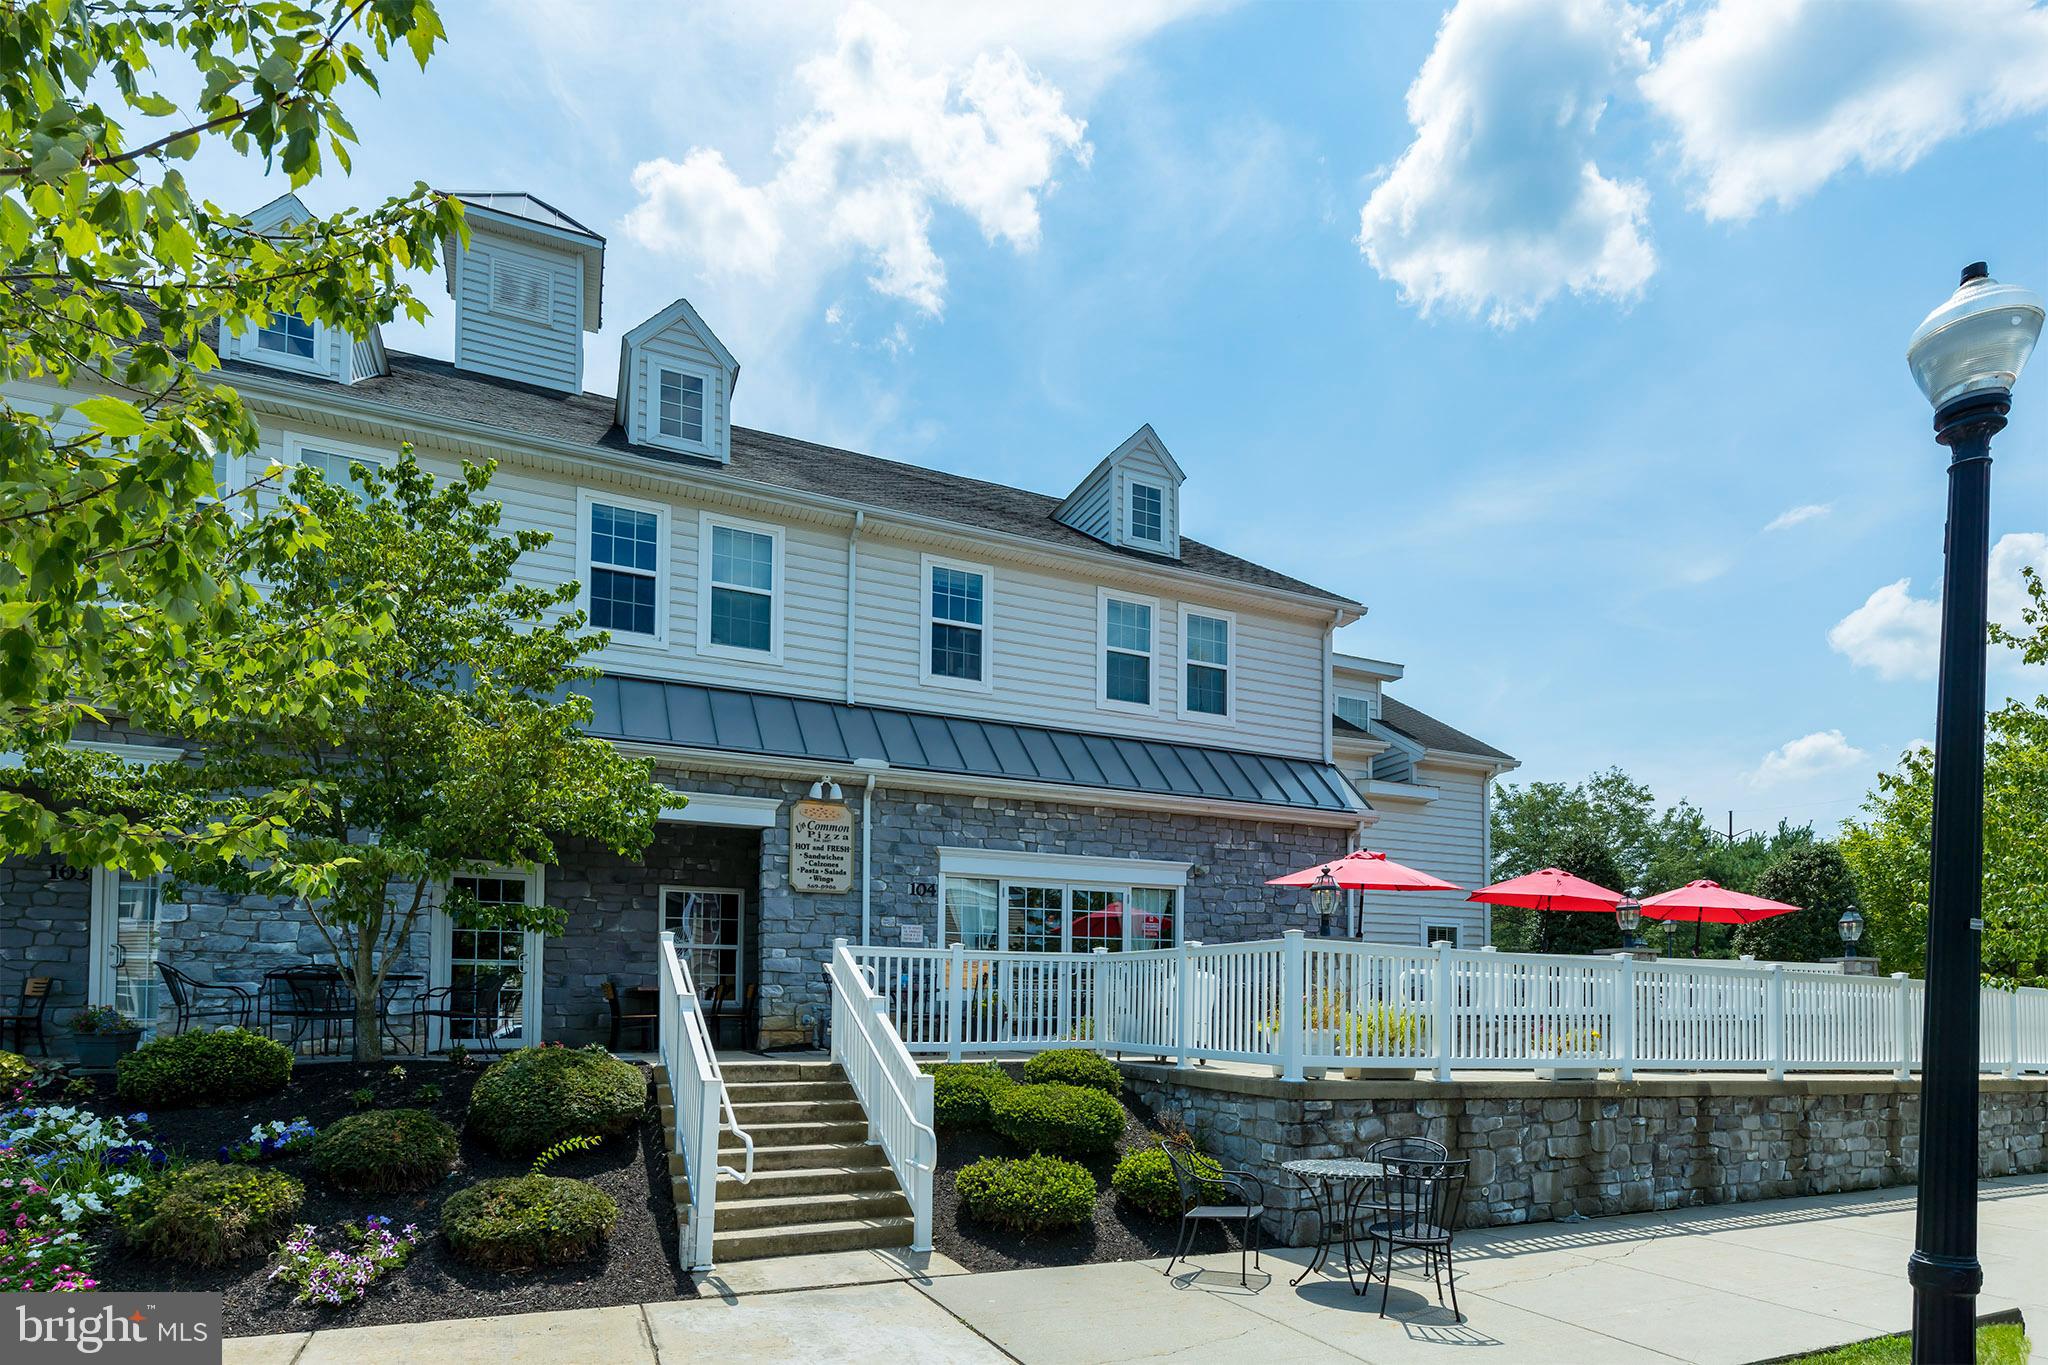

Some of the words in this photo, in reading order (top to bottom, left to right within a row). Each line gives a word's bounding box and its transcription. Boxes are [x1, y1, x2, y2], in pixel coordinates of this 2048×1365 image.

[807, 820, 850, 833] Common
[807, 830, 849, 841] Pizza
[803, 852, 844, 861] Sandwiches
[808, 860, 839, 868] Calzones
[824, 868, 847, 876] Salads
[813, 875, 834, 884] Wings
[909, 882, 937, 897] 104
